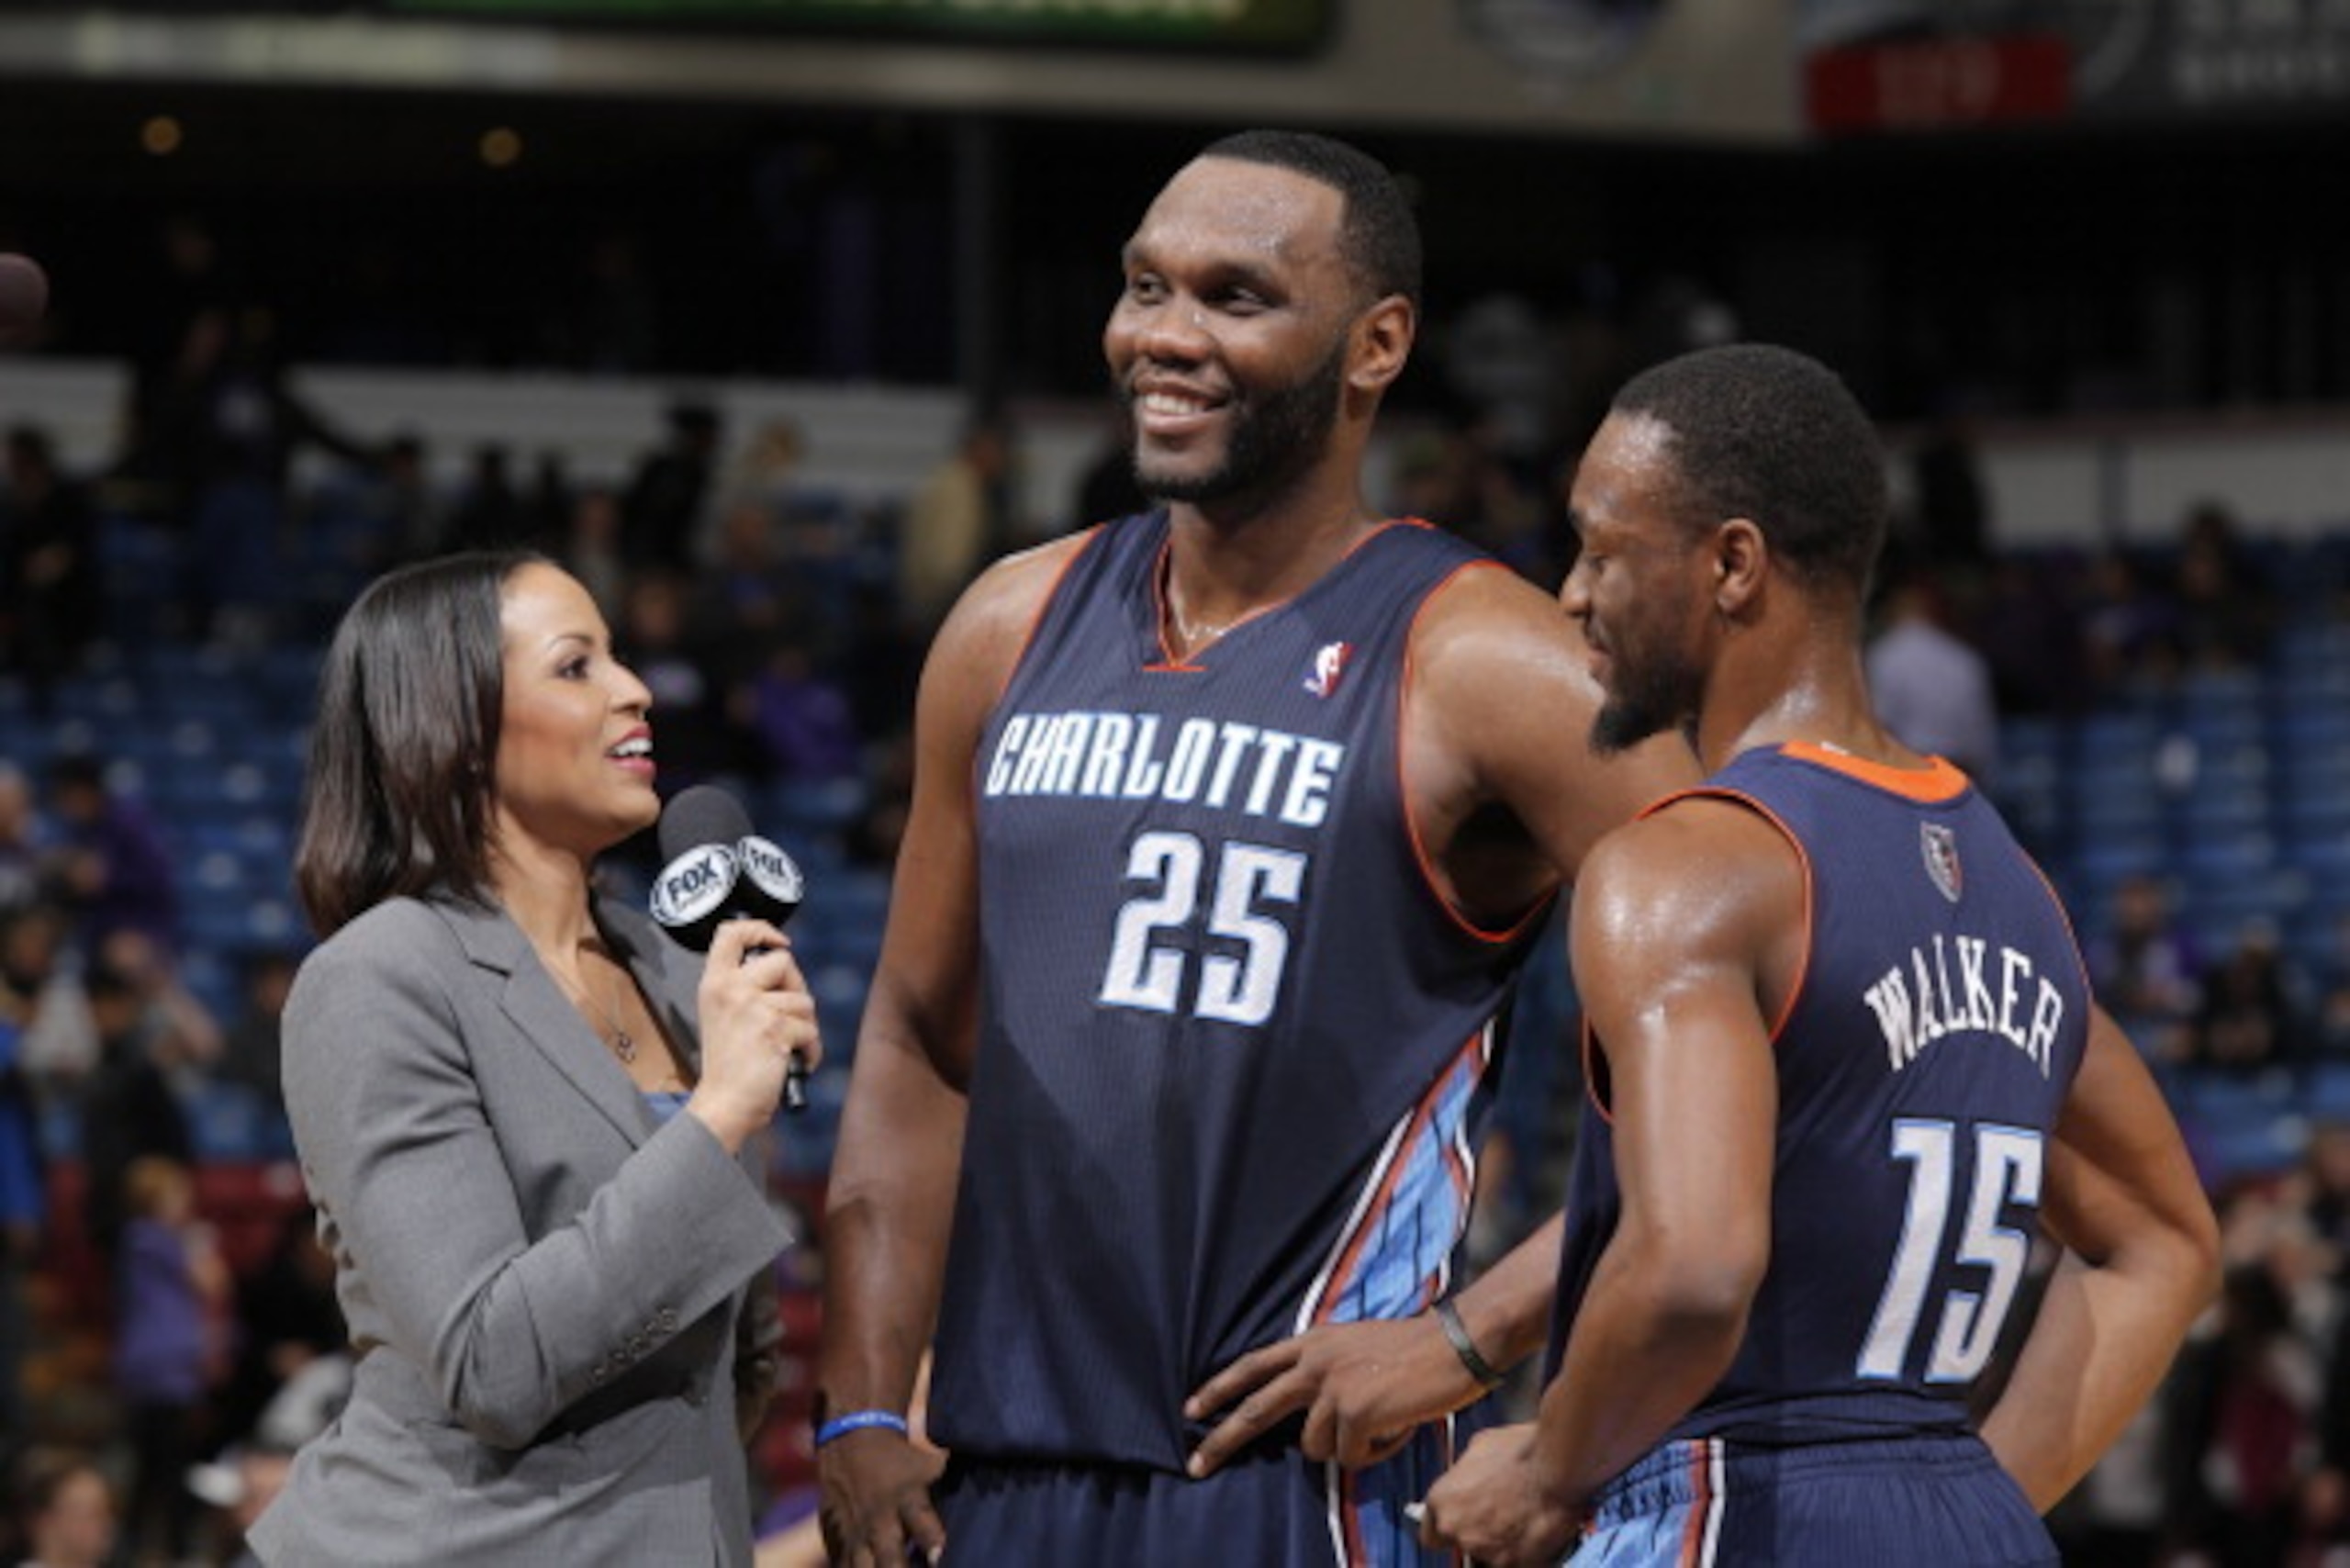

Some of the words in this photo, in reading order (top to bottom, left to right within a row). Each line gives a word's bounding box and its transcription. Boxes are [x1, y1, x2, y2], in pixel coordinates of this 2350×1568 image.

[985, 710, 1345, 827] CHARLOTTE
[666, 855, 719, 902] FOX
[1097, 831, 1307, 1027] 25
[1863, 934, 2064, 1081] WALKER
[1855, 1116, 2043, 1383] 15
